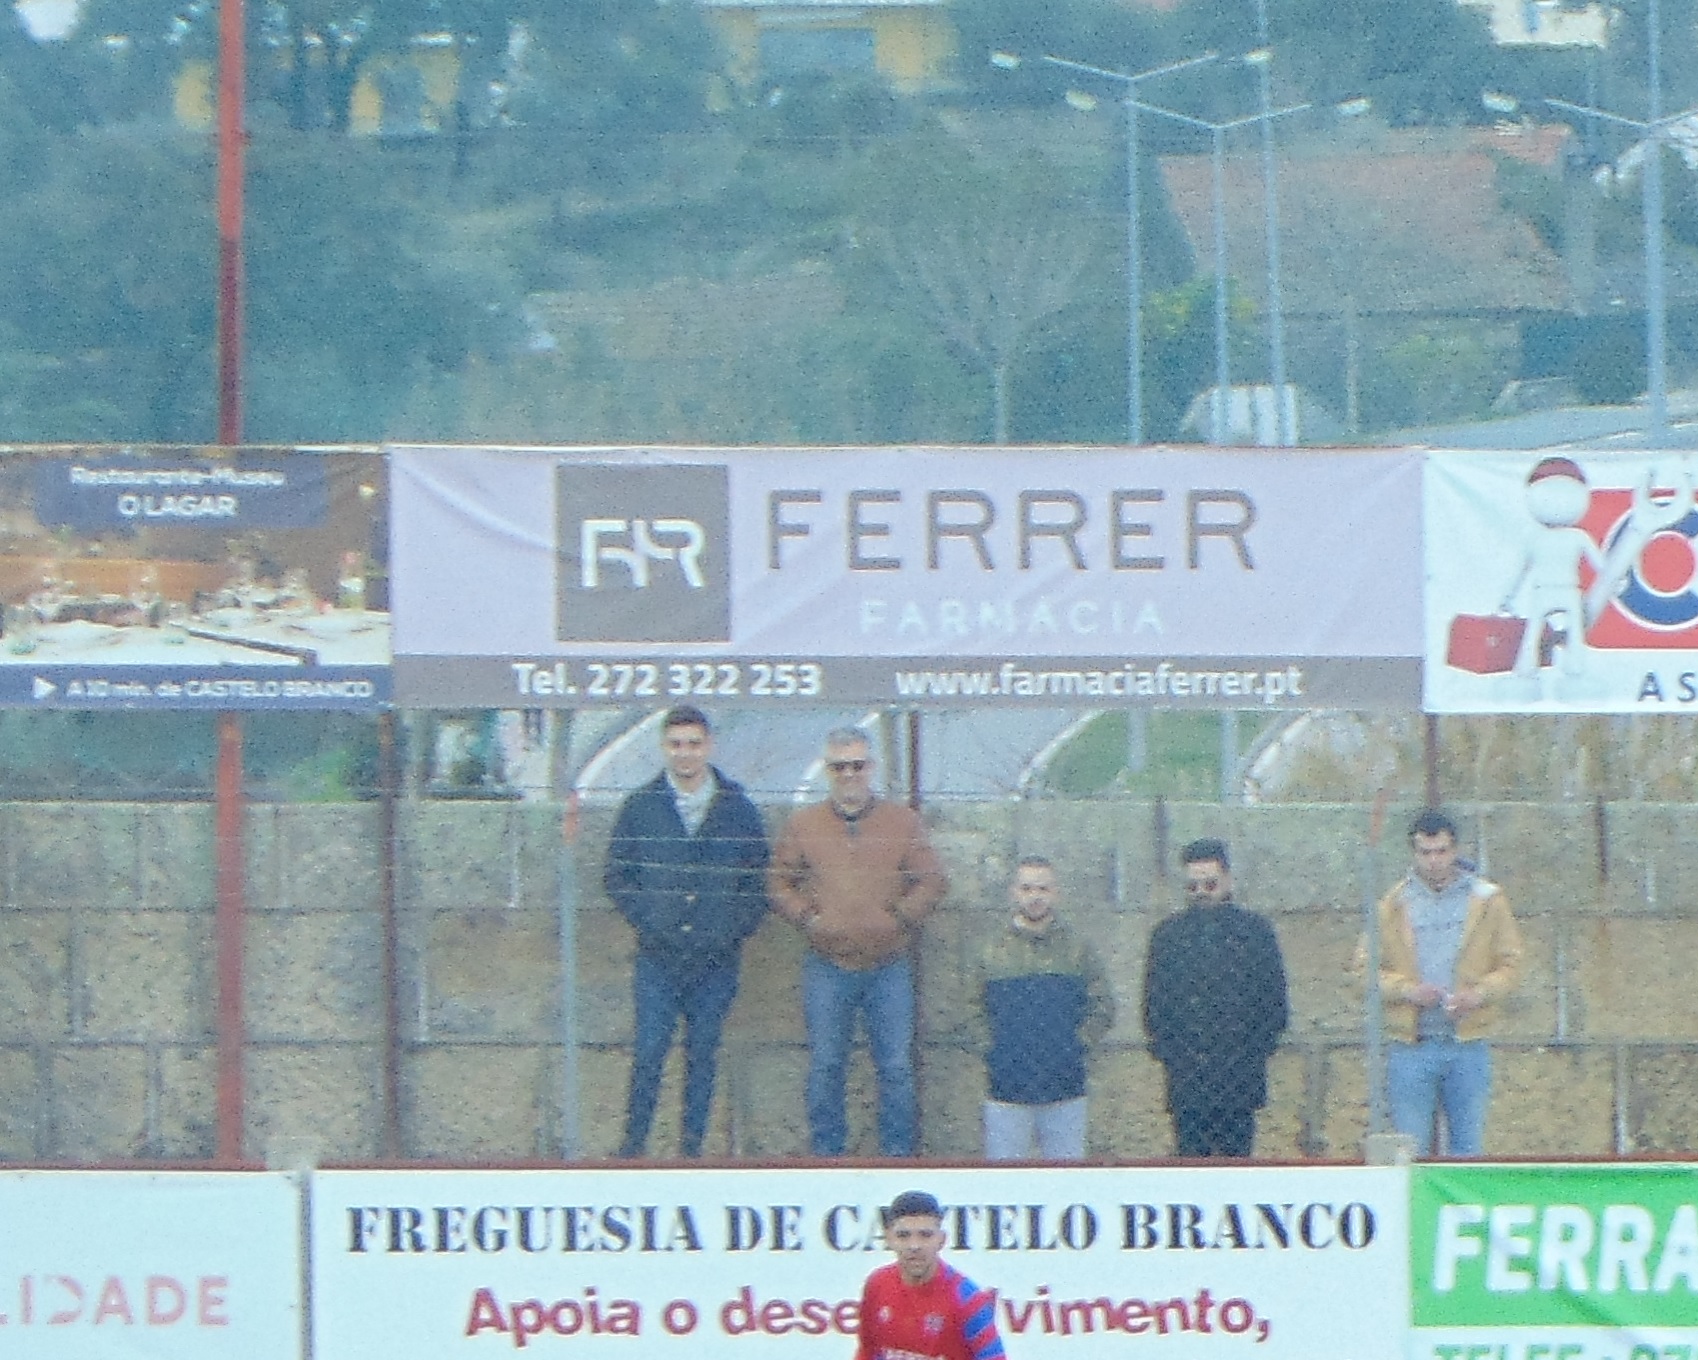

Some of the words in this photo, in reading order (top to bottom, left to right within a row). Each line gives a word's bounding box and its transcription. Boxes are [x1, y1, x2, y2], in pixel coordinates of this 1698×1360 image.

[144, 494, 238, 517] LAGAR
[767, 488, 1259, 572] FERRER
[858, 599, 1165, 635] FARMACIA
[511, 662, 576, 696] Tel.
[588, 663, 660, 697] 272
[668, 663, 741, 697] 322
[749, 663, 824, 697] 253
[895, 662, 1304, 702] www.farmaciaferrer.pt
[1637, 671, 1663, 703] A
[346, 1203, 703, 1254] FREGUESIA
[723, 1202, 803, 1253] DE
[1119, 1200, 1378, 1251] BRANCO
[0, 1274, 230, 1326] IDADE
[464, 1286, 642, 1348] Apoia
[661, 1300, 698, 1336] o
